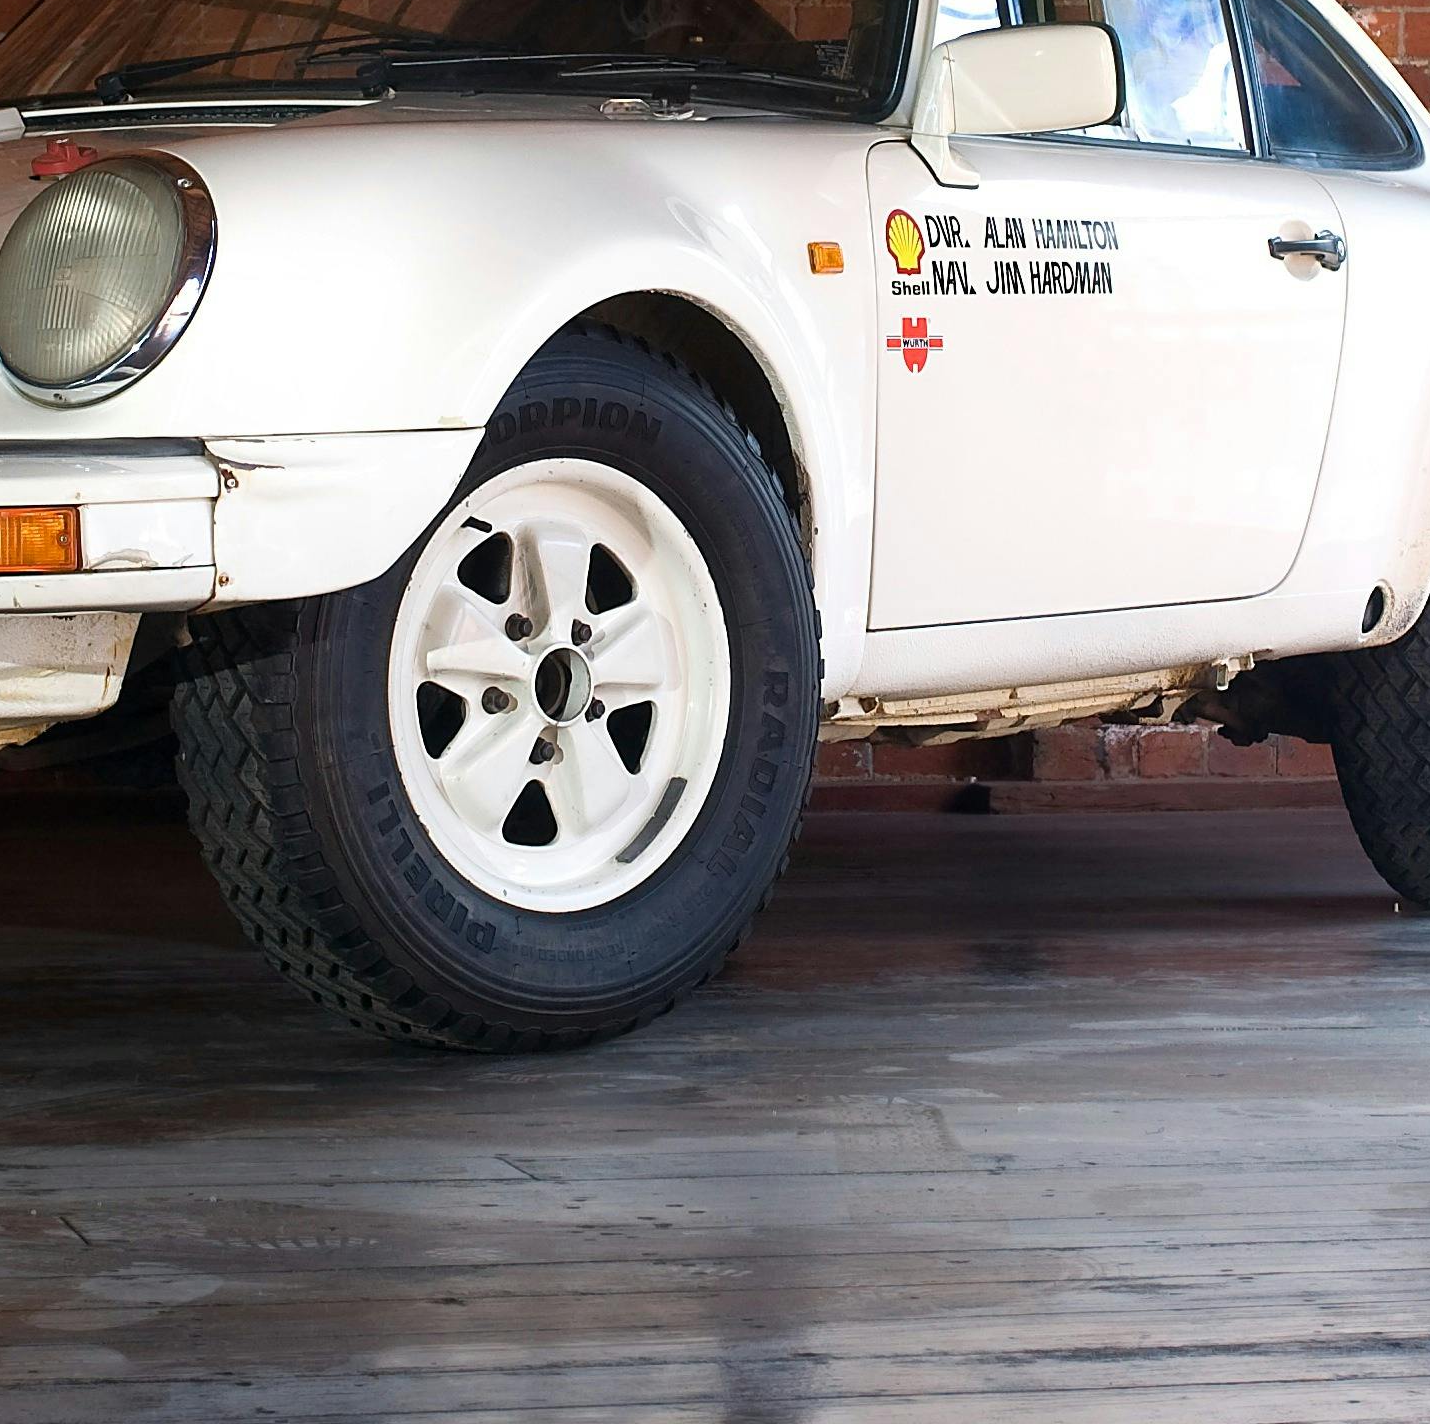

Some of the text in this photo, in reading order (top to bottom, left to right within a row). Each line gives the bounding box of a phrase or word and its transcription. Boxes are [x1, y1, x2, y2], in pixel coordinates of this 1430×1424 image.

[924, 214, 1120, 251] DVR. ALAN HAMILTON
[891, 280, 930, 296] Shell
[931, 260, 1113, 295] NAV. JIM HARDMAN
[482, 397, 664, 456] ORPION
[706, 671, 789, 877] RADIAL
[367, 781, 497, 954] PIRELLI
